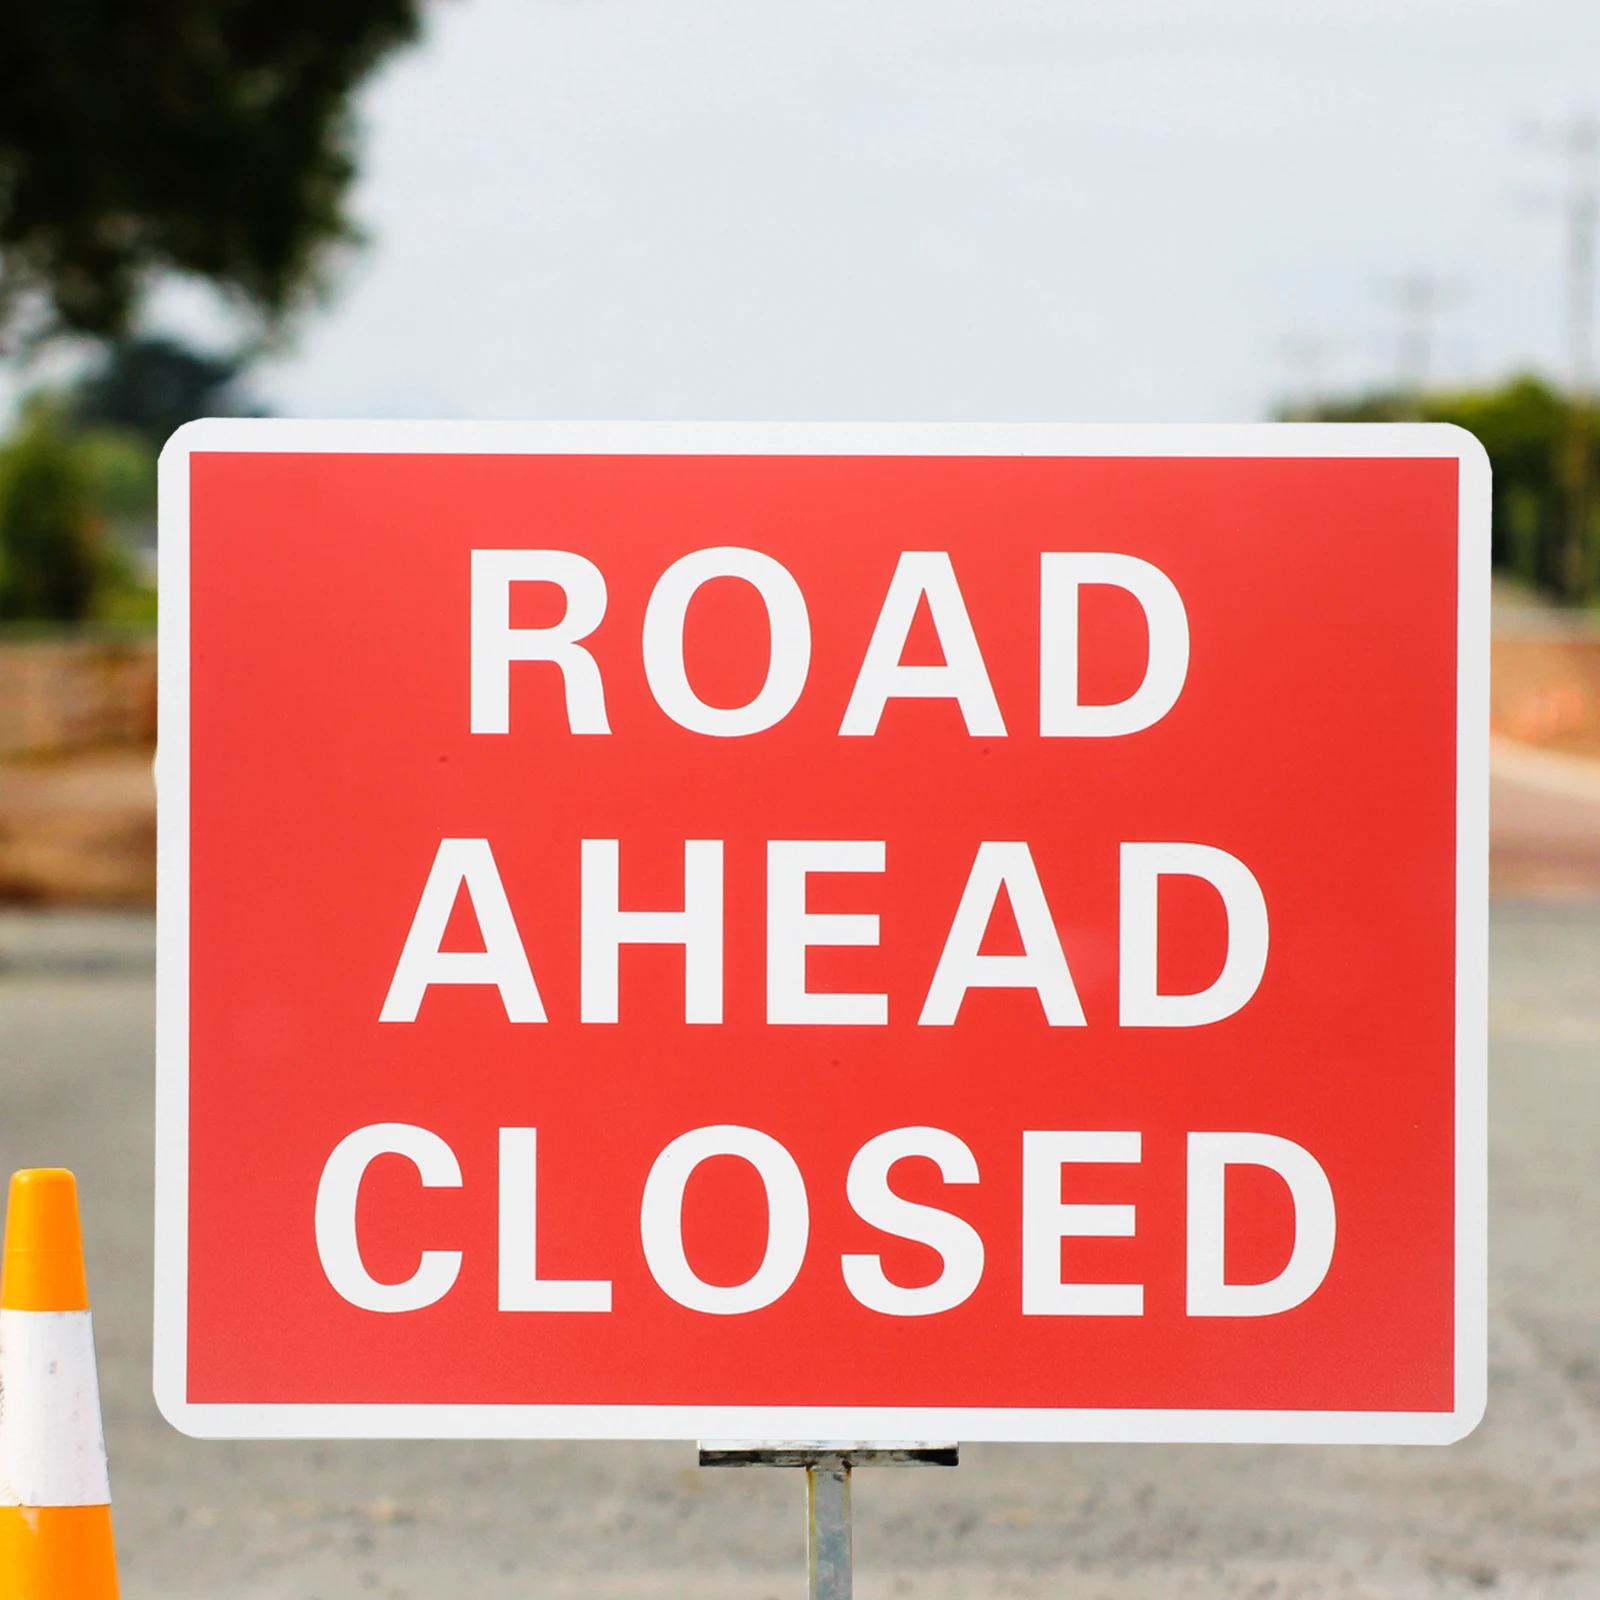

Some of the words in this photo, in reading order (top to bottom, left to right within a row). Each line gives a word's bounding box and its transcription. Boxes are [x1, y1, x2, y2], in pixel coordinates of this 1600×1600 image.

[470, 546, 1190, 738] ROAD
[379, 837, 1270, 1028] AHEAD
[314, 1122, 1337, 1317] CLOSED
